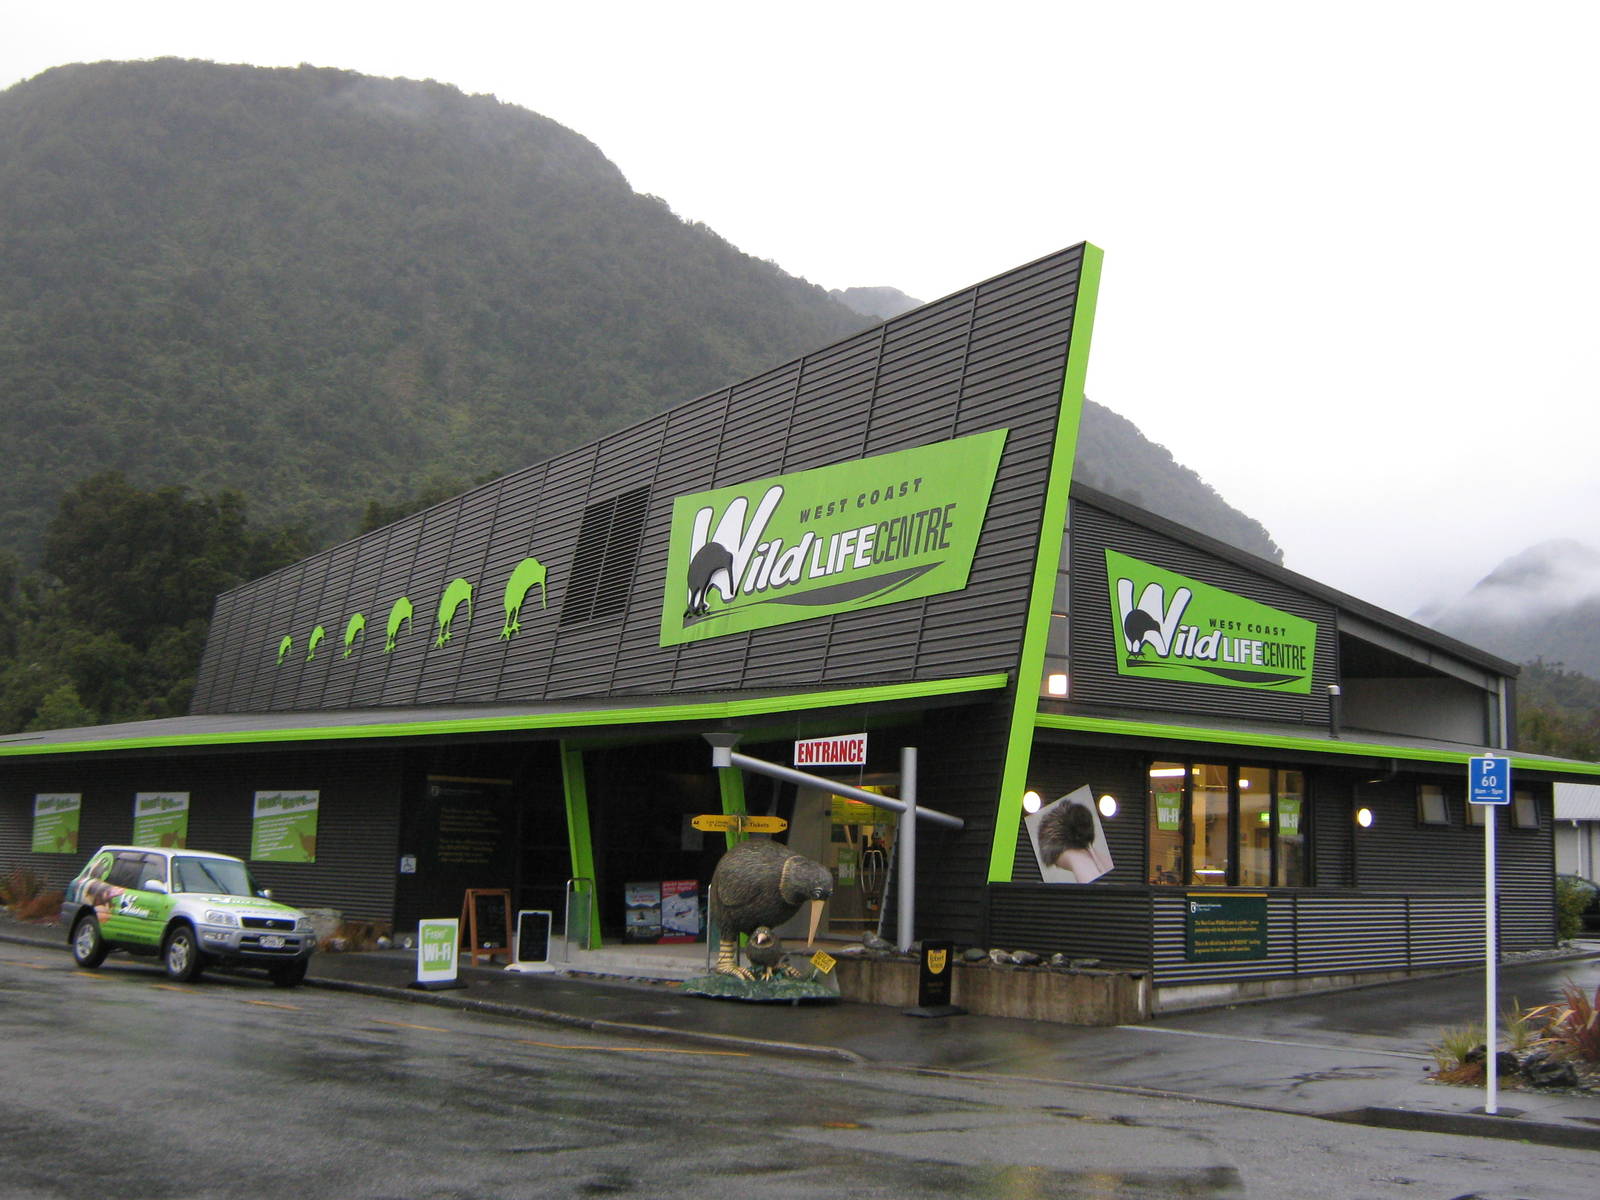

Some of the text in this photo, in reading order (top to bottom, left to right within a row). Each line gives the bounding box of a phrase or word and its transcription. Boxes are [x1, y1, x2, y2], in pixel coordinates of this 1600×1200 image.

[800, 477, 923, 523] WEST COAST
[1209, 618, 1286, 637] WEST COAST
[797, 739, 864, 763] ENTRANCE
[1482, 760, 1495, 775] P
[1481, 775, 1497, 787] 60
